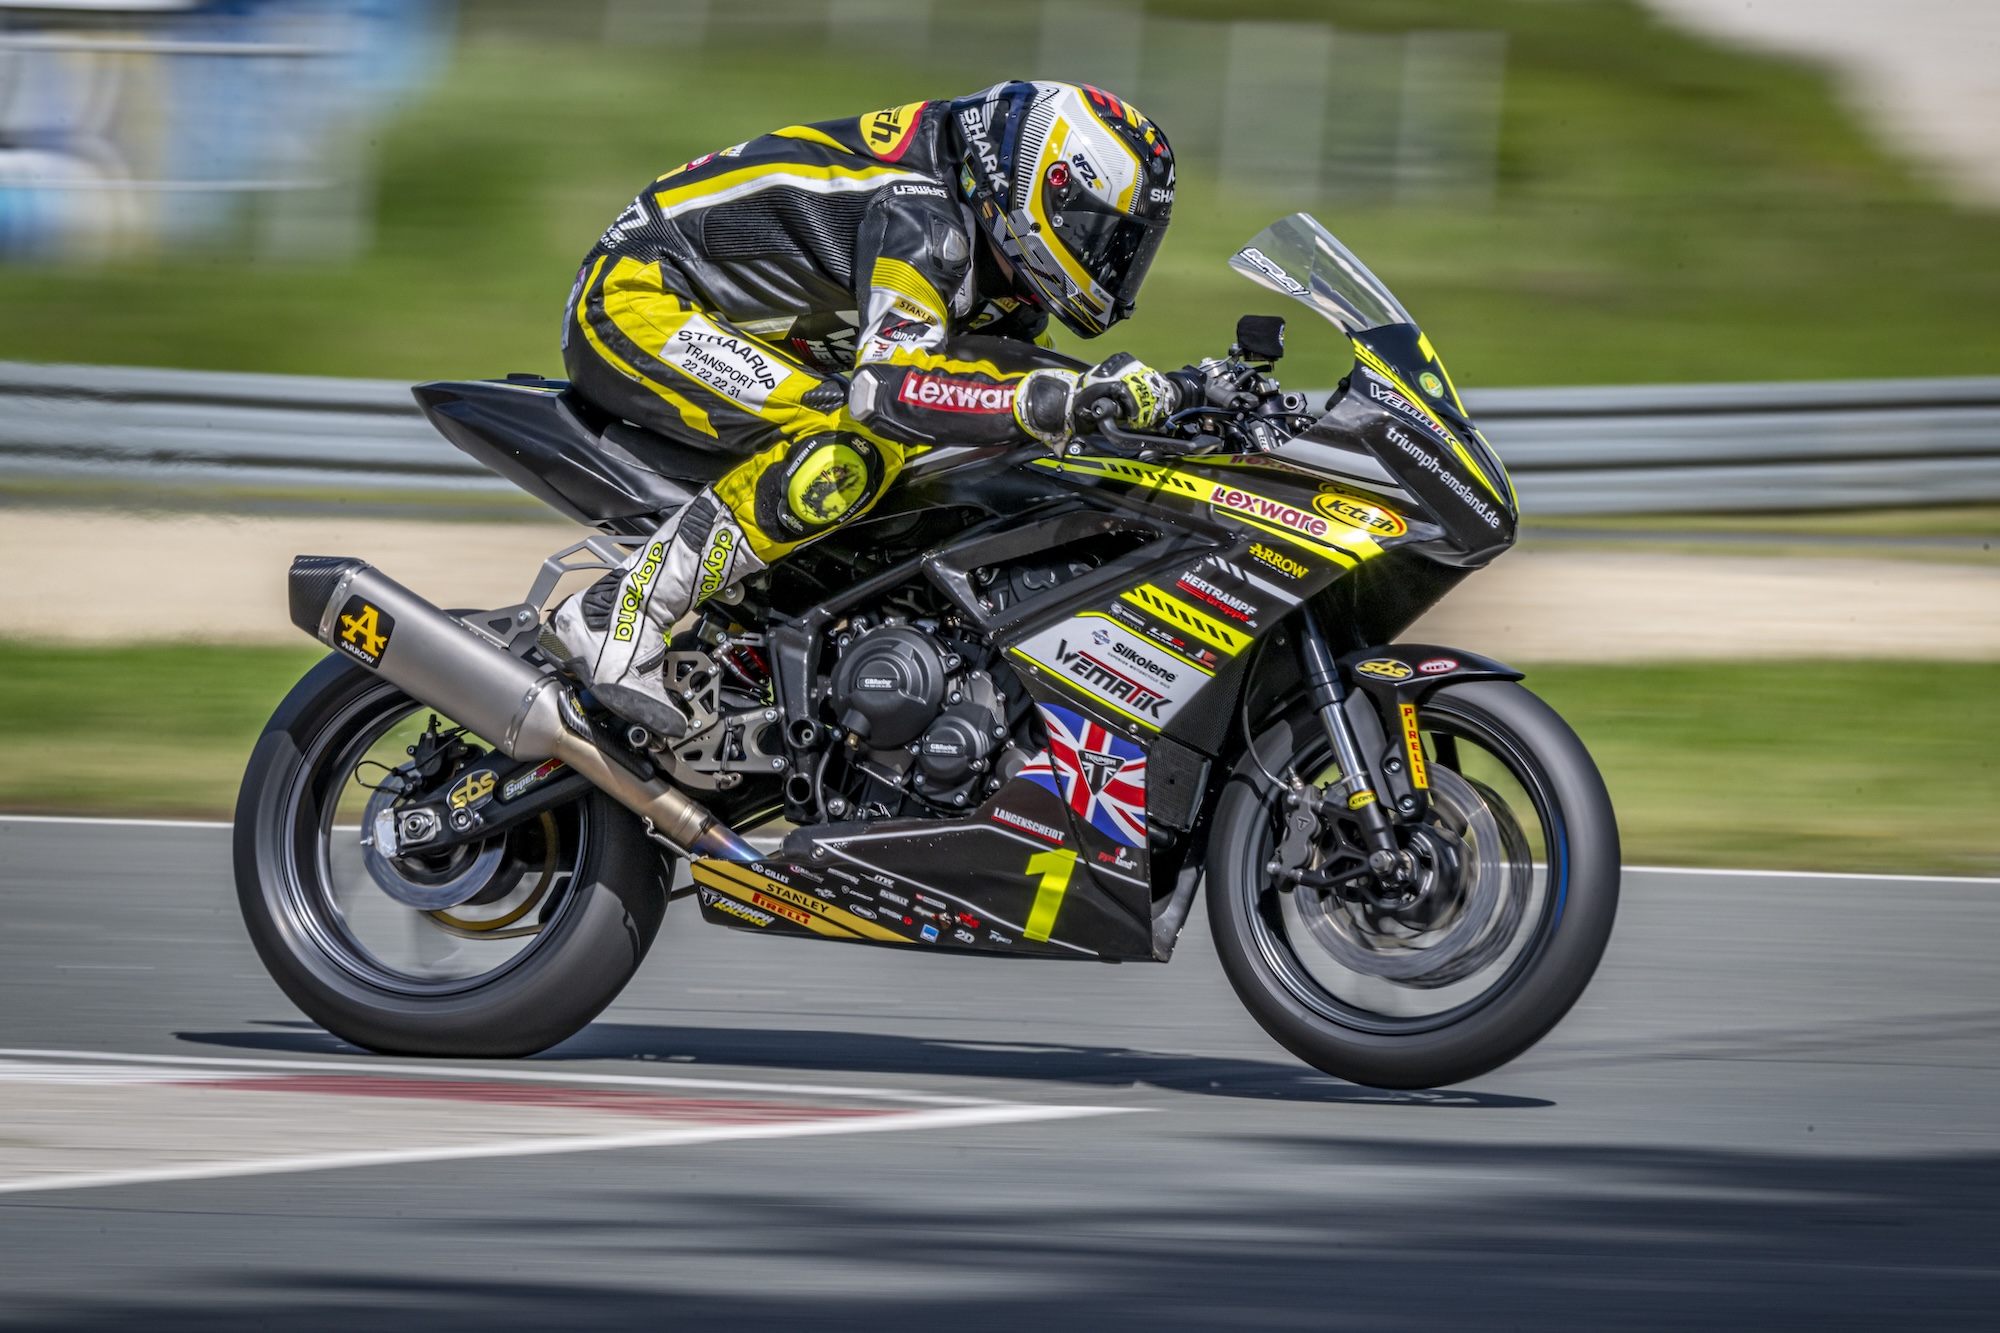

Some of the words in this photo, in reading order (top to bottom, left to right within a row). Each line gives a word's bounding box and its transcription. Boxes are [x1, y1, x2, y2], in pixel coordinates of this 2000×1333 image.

[964, 107, 1009, 192] SHARK
[1150, 188, 1175, 203] SHA
[677, 330, 776, 390] STRAARUP
[682, 359, 698, 373] 22
[696, 367, 713, 382] 22
[712, 376, 728, 391] 22
[727, 385, 741, 399] 31
[685, 342, 757, 389] TRANSPORT
[903, 378, 1015, 409] Lexwar
[1386, 426, 1500, 528] triumph-emsland.de
[1210, 486, 1328, 536] Lexware
[696, 528, 734, 608] dayto
[1249, 542, 1309, 579] ARROW
[614, 542, 664, 642] daytona
[1181, 571, 1257, 615] HERTRAMPF
[341, 640, 375, 664] ARROW
[1112, 642, 1176, 683] Silkolene
[1358, 660, 1411, 679] sbs
[1404, 707, 1425, 785] PIRELLI
[451, 771, 496, 809] sbs
[993, 806, 1065, 841] LANGENSCHEIDT
[764, 868, 790, 884] GILLES
[1022, 847, 1079, 943] 1
[713, 901, 769, 928] RACING
[718, 897, 776, 924] TRIUMPH
[751, 892, 811, 925] PIRELLI
[766, 883, 830, 914] STANLEY
[953, 928, 976, 945] 2D
